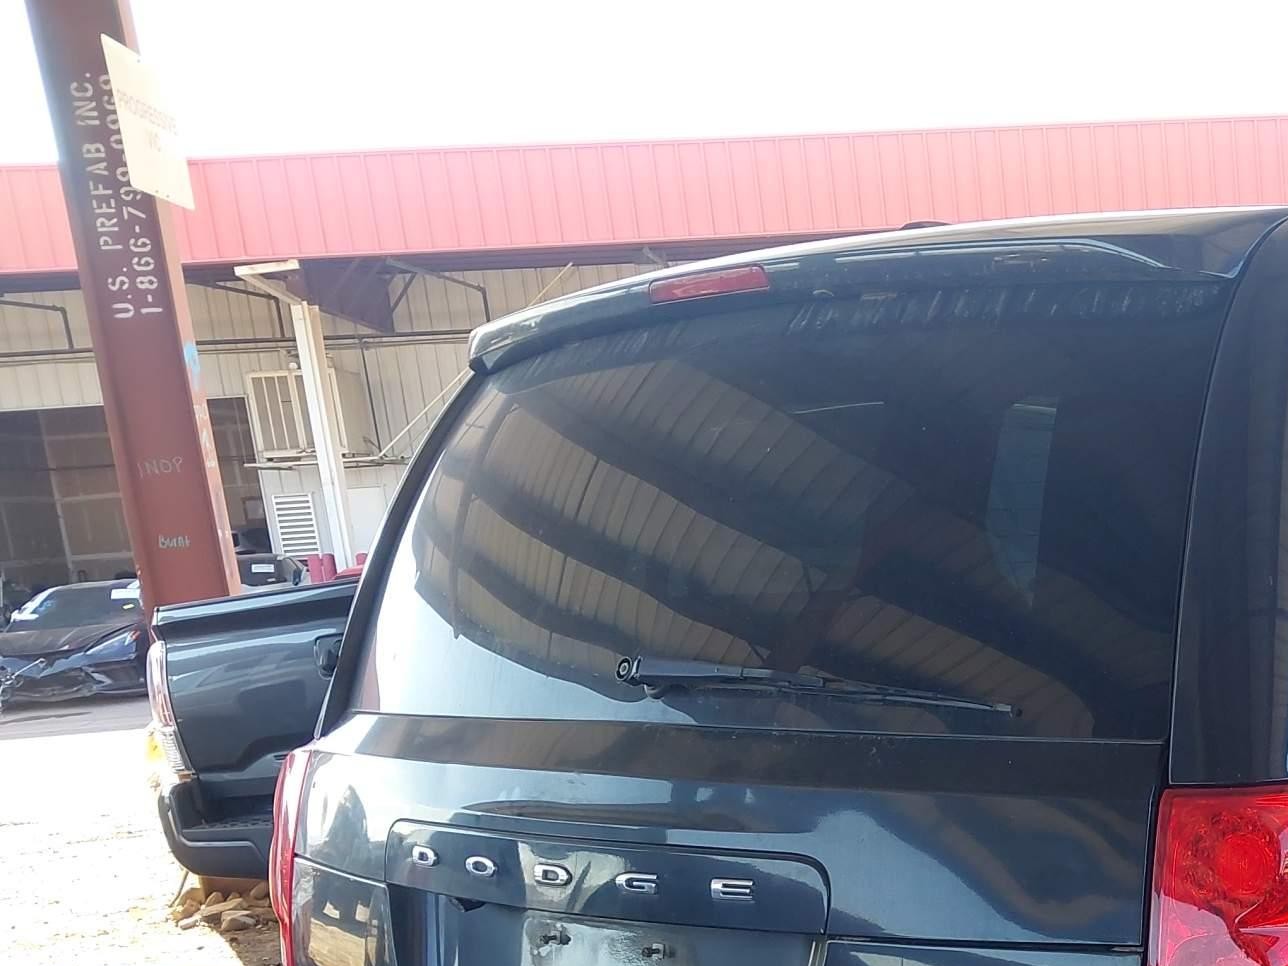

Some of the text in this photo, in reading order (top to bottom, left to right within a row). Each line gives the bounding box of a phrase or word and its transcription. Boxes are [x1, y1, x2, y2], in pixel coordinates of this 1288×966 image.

[69, 71, 135, 319] U.S. PREFAB INC.
[410, 844, 756, 902] DODGE
